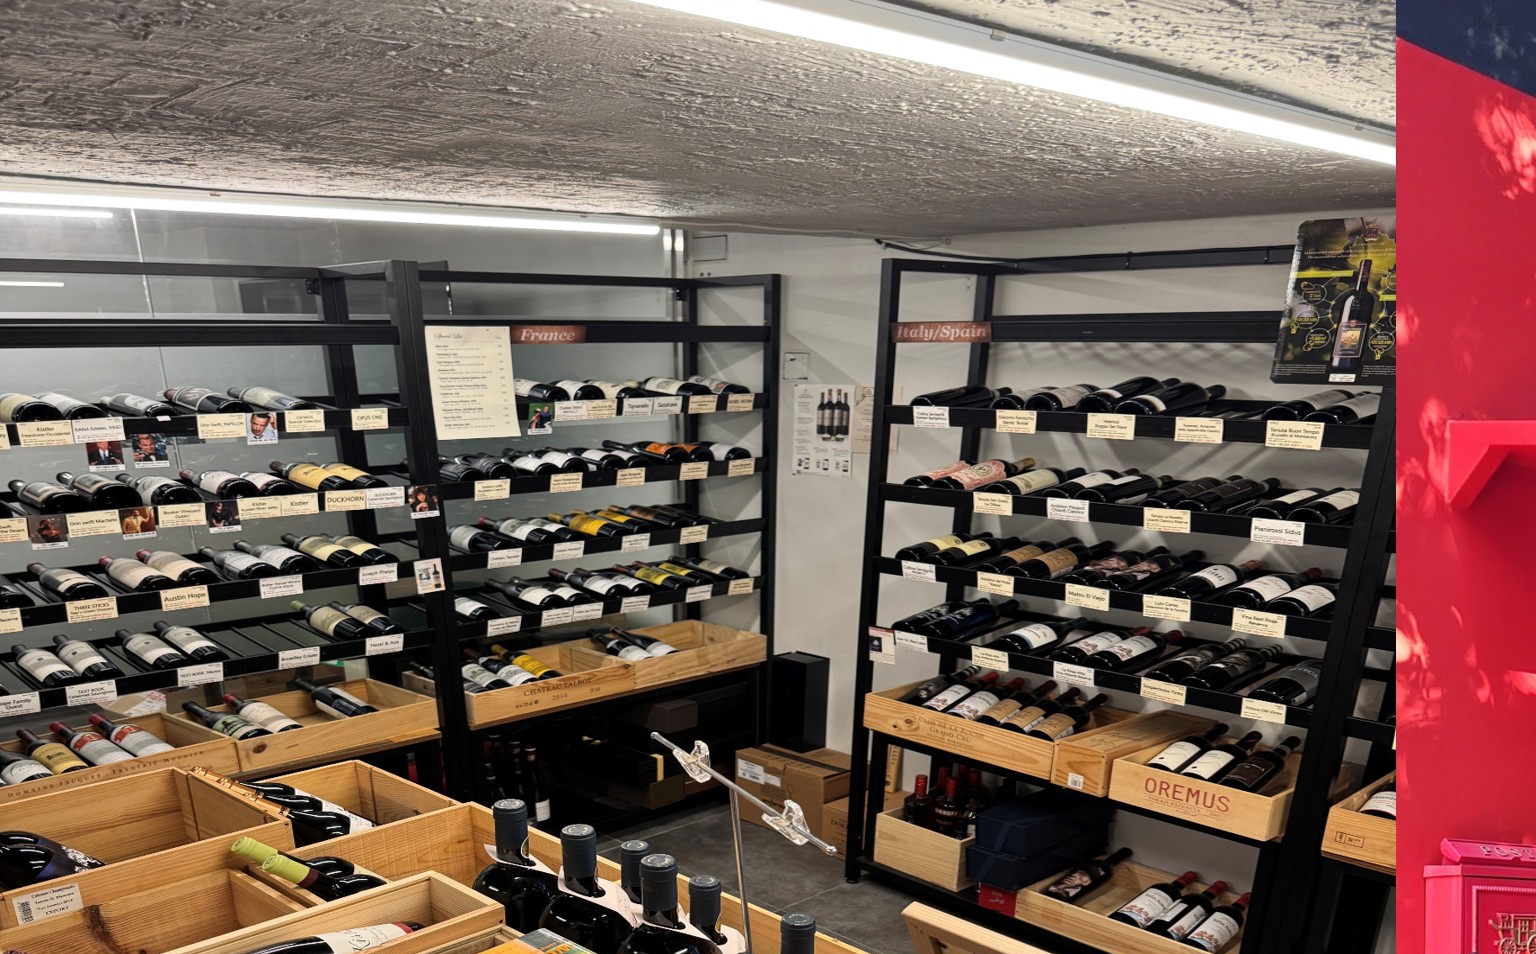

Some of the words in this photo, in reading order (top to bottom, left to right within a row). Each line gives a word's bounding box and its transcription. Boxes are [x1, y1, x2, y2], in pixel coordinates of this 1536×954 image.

[520, 328, 575, 341] France
[897, 326, 986, 341] Italy/Spain
[1302, 429, 1320, 437] Tempo
[164, 595, 186, 603] Austin
[187, 592, 206, 601] Hope
[7, 781, 56, 798] DOMAINE
[1145, 777, 1230, 812] OREMUS
[1478, 844, 1536, 861] POST
